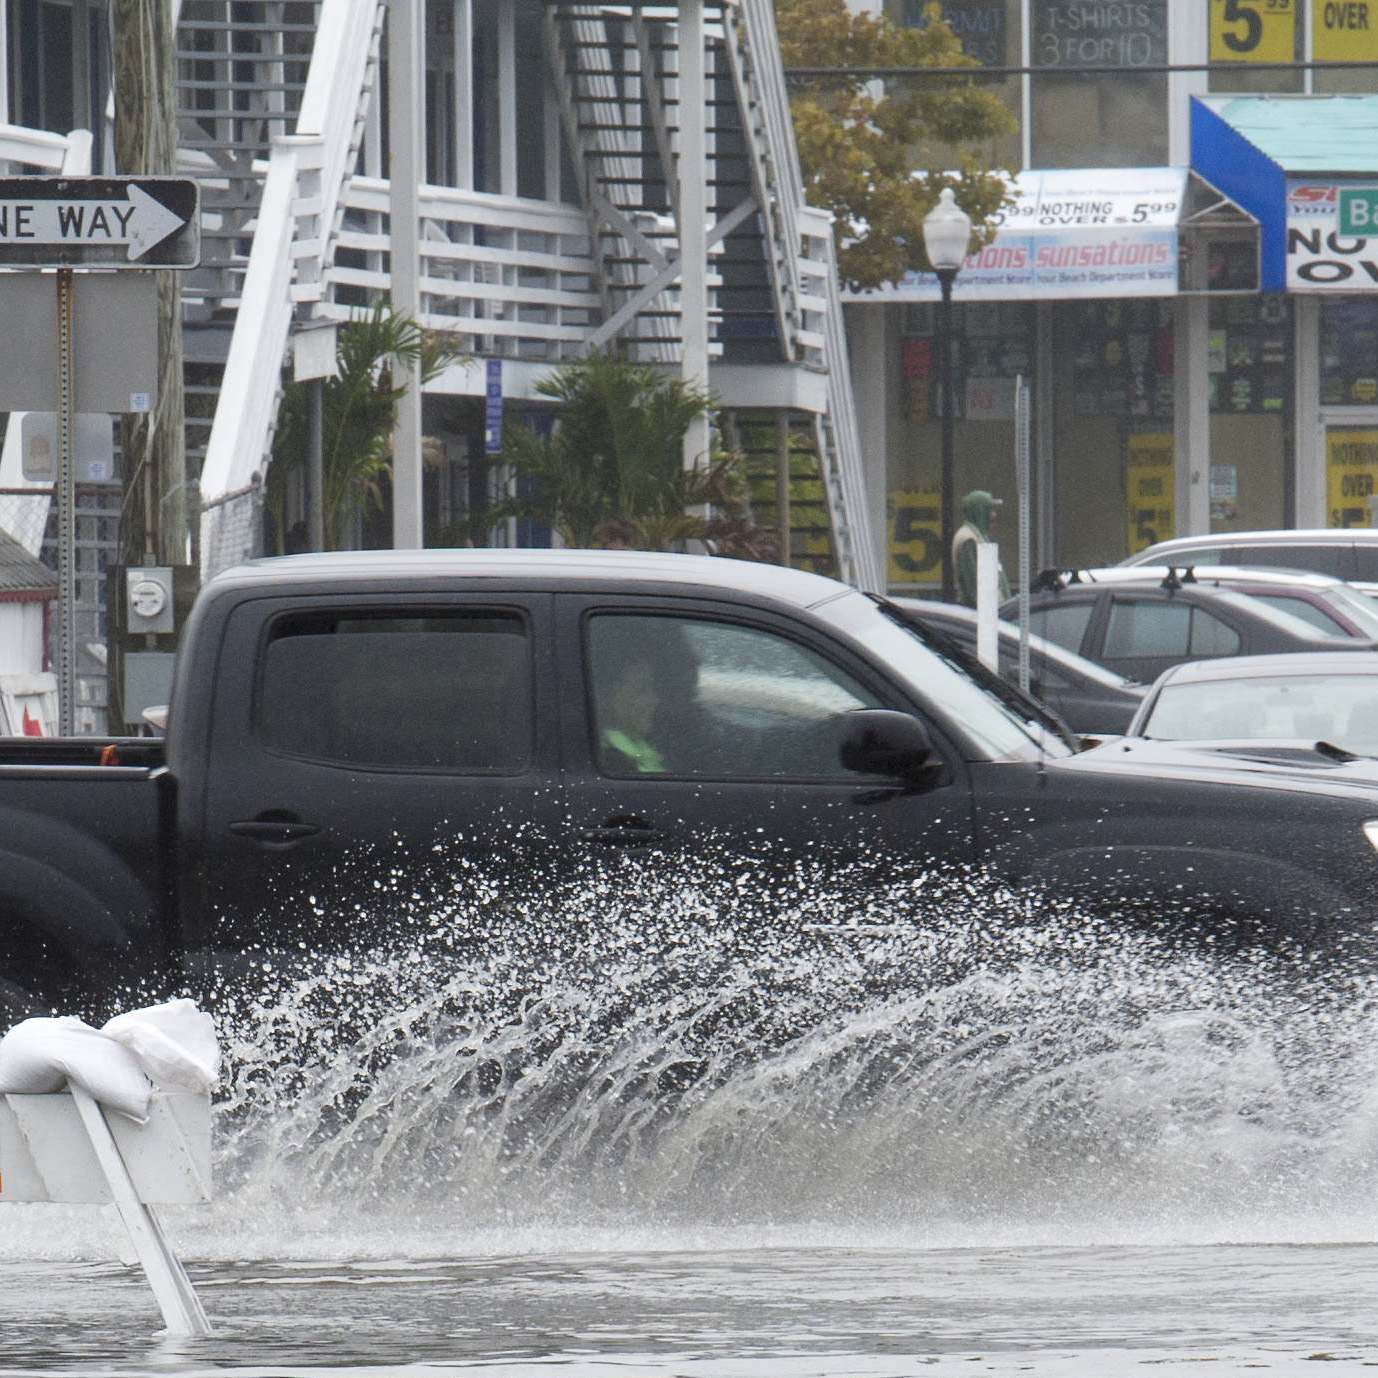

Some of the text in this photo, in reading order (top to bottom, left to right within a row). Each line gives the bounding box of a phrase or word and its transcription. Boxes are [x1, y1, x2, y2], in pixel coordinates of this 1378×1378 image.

[1047, 4, 1152, 31] T-SHIRTS
[1324, 6, 1370, 30] OVER
[1040, 33, 1061, 67] 3
[1066, 38, 1115, 61] FOR
[1038, 214, 1107, 225] OVER
[1039, 202, 1114, 216] NOTHING
[57, 205, 137, 239] WAY
[1035, 240, 1169, 267] sunsations
[1088, 269, 1147, 285] Department
[1341, 473, 1374, 498] OVER
